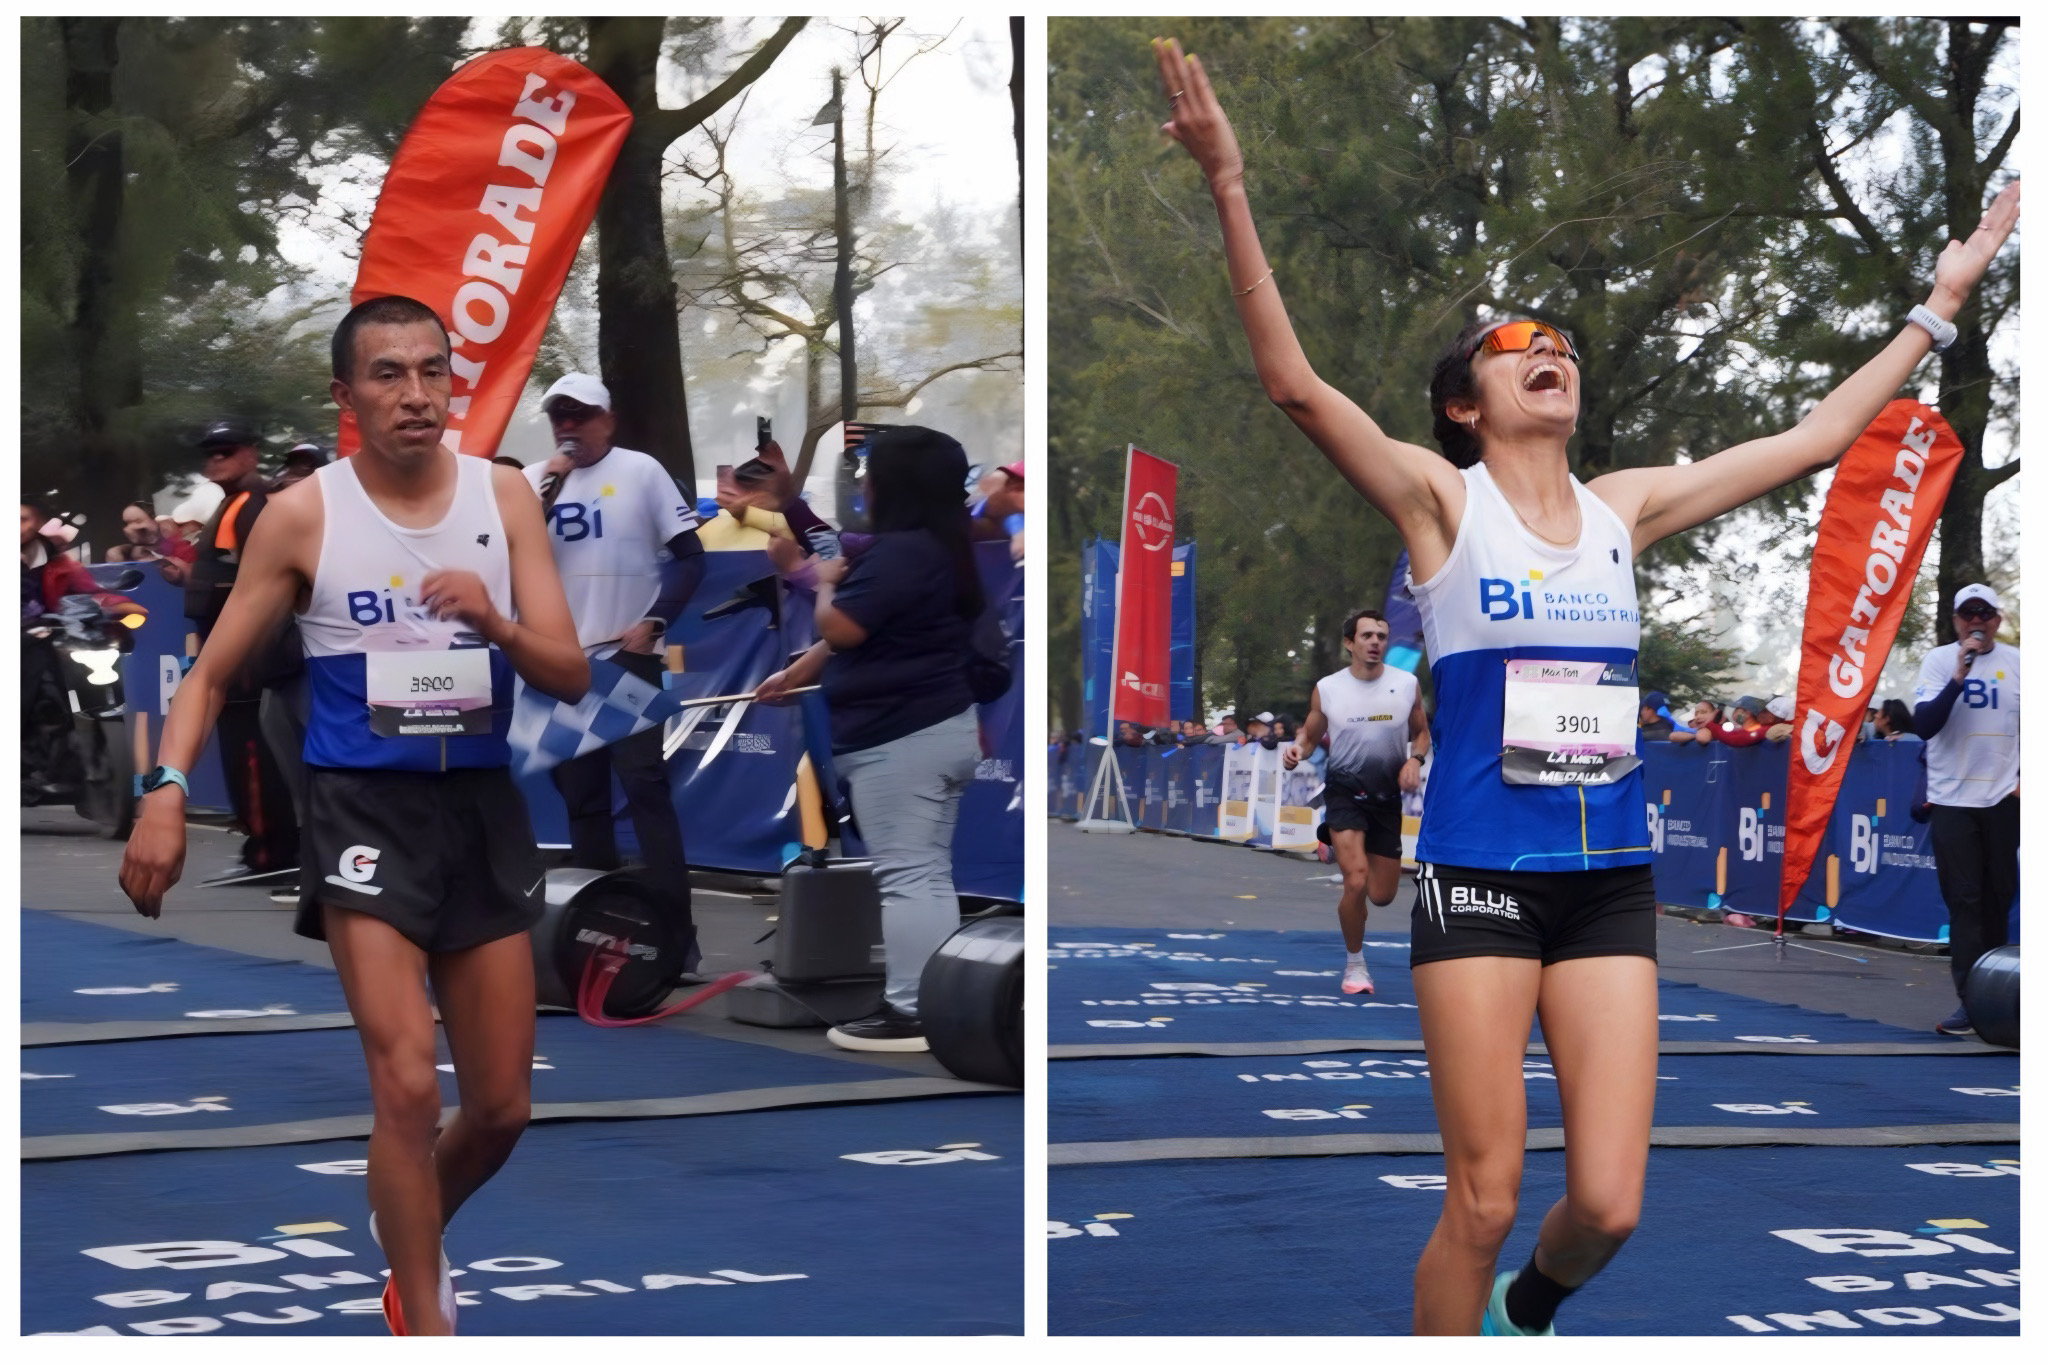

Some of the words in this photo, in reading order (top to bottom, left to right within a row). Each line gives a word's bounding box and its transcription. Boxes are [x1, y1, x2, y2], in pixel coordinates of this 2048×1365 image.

[450, 72, 577, 454] TORADE
[554, 484, 616, 541] Bi
[1829, 417, 1937, 699] GATORADE
[347, 576, 404, 627] Bi
[1480, 569, 1543, 622] Bi
[1544, 592, 1608, 605] BANCO
[1963, 670, 2004, 709] Bi
[1556, 715, 1601, 734] 3901
[1546, 751, 1567, 763] LA
[1739, 792, 1771, 862] Bi
[1850, 798, 1886, 874] Bi
[1450, 905, 1520, 920] CORPORATION
[1451, 886, 1519, 913] BLUE
[79, 1221, 355, 1270] Bi
[1768, 1218, 2015, 1257] Bi
[93, 1256, 564, 1308] BANO
[1725, 1302, 2020, 1333] INDU
